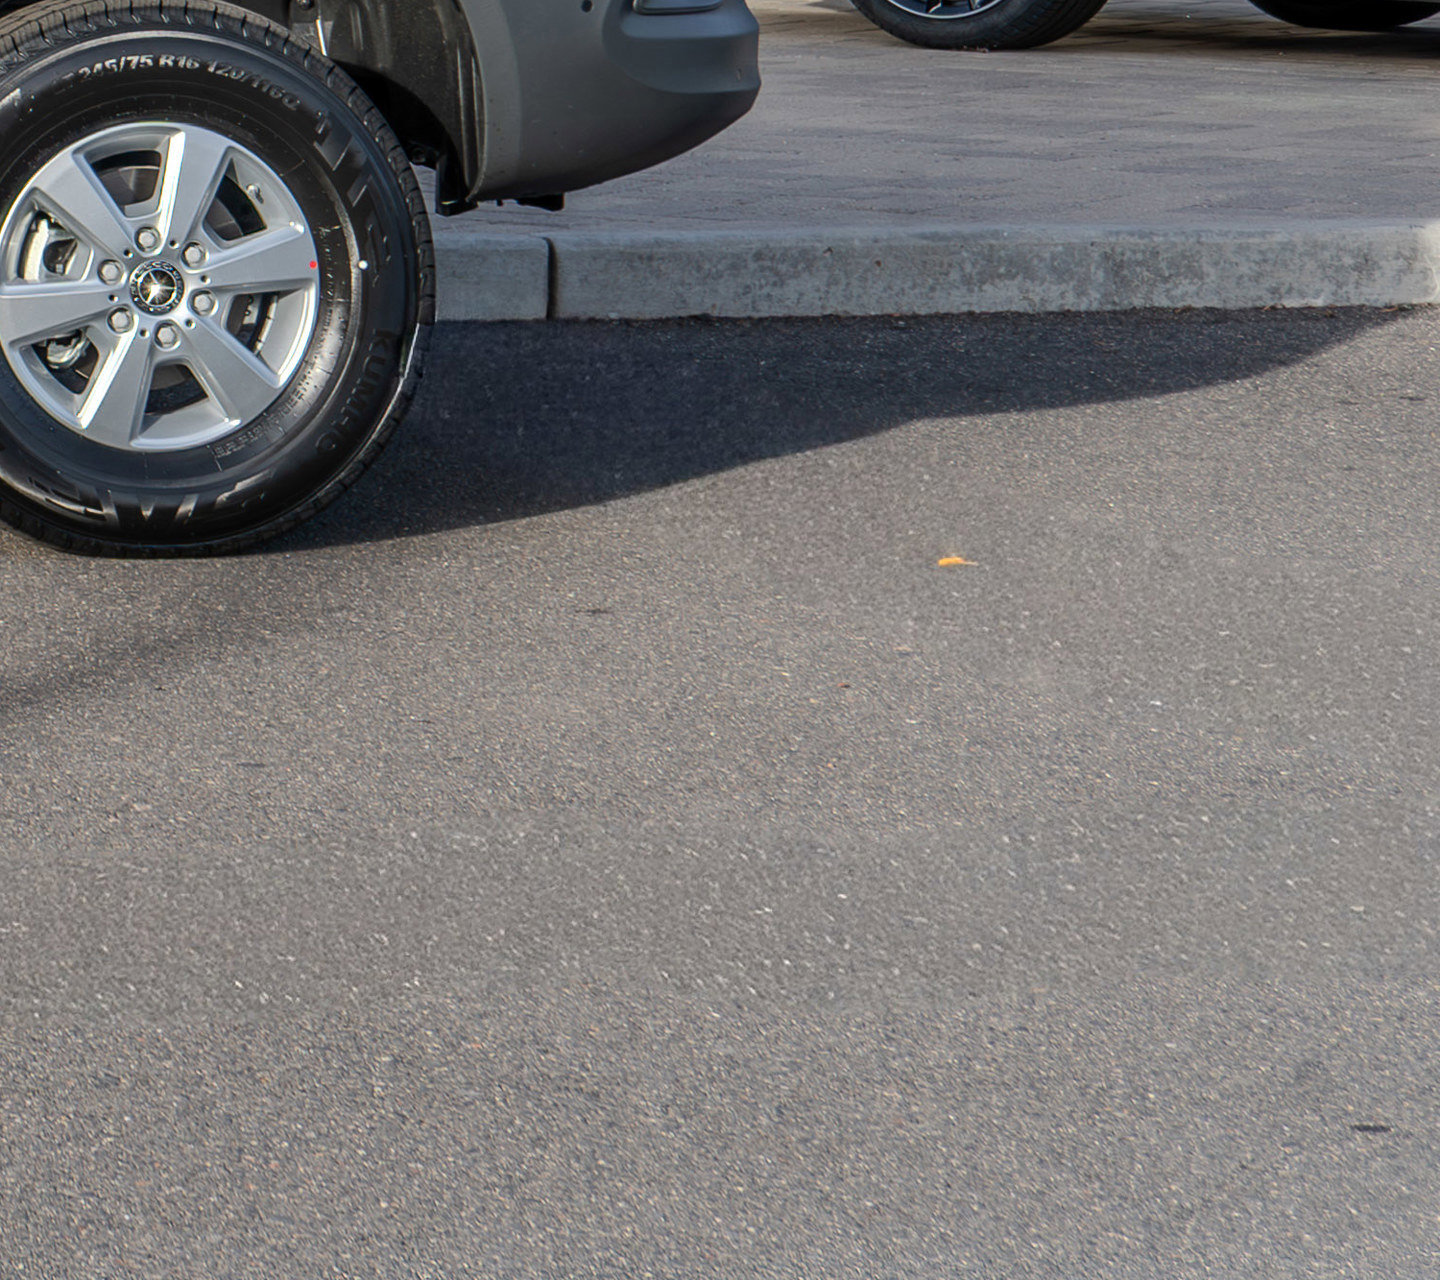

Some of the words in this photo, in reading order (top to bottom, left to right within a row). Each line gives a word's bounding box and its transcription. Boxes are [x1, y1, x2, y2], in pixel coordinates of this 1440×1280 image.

[76, 52, 155, 84] 245/75
[158, 52, 201, 71] R16
[314, 325, 396, 455] KUMHO
